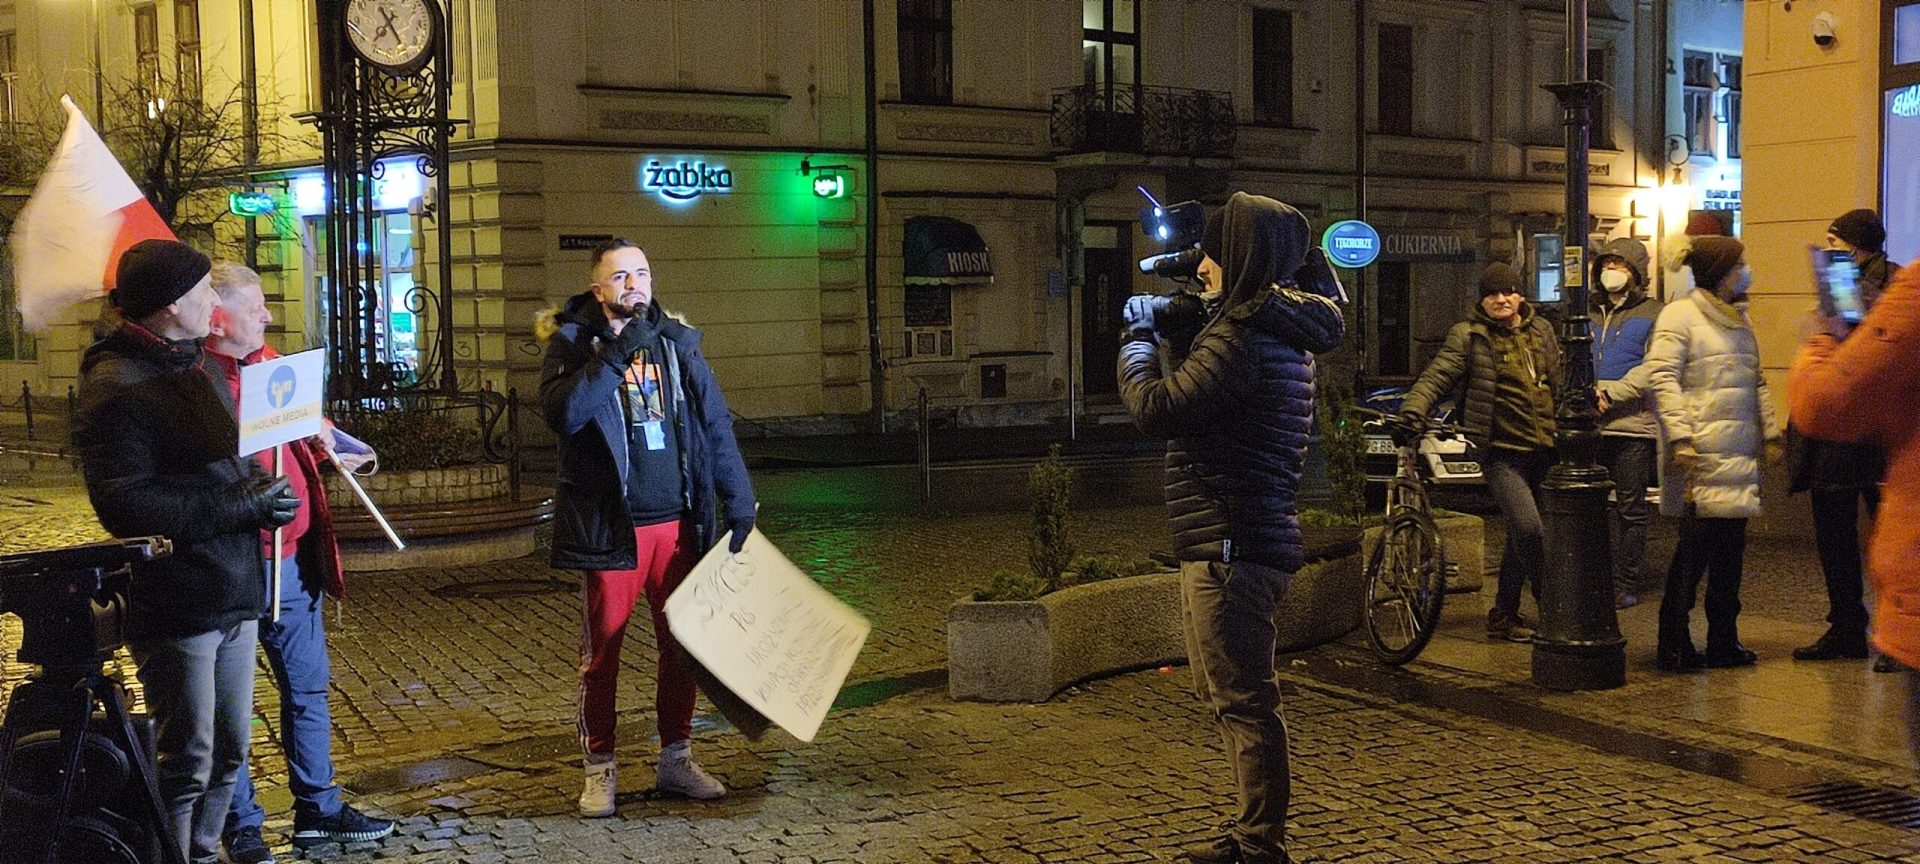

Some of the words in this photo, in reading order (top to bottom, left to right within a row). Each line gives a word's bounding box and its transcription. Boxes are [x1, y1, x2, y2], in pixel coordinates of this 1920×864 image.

[646, 161, 733, 188] żabka
[1385, 234, 1462, 255] CUKIERNIA
[947, 251, 990, 273] KIOSK
[251, 415, 280, 432] WOLNE
[283, 408, 309, 421] MEDIA
